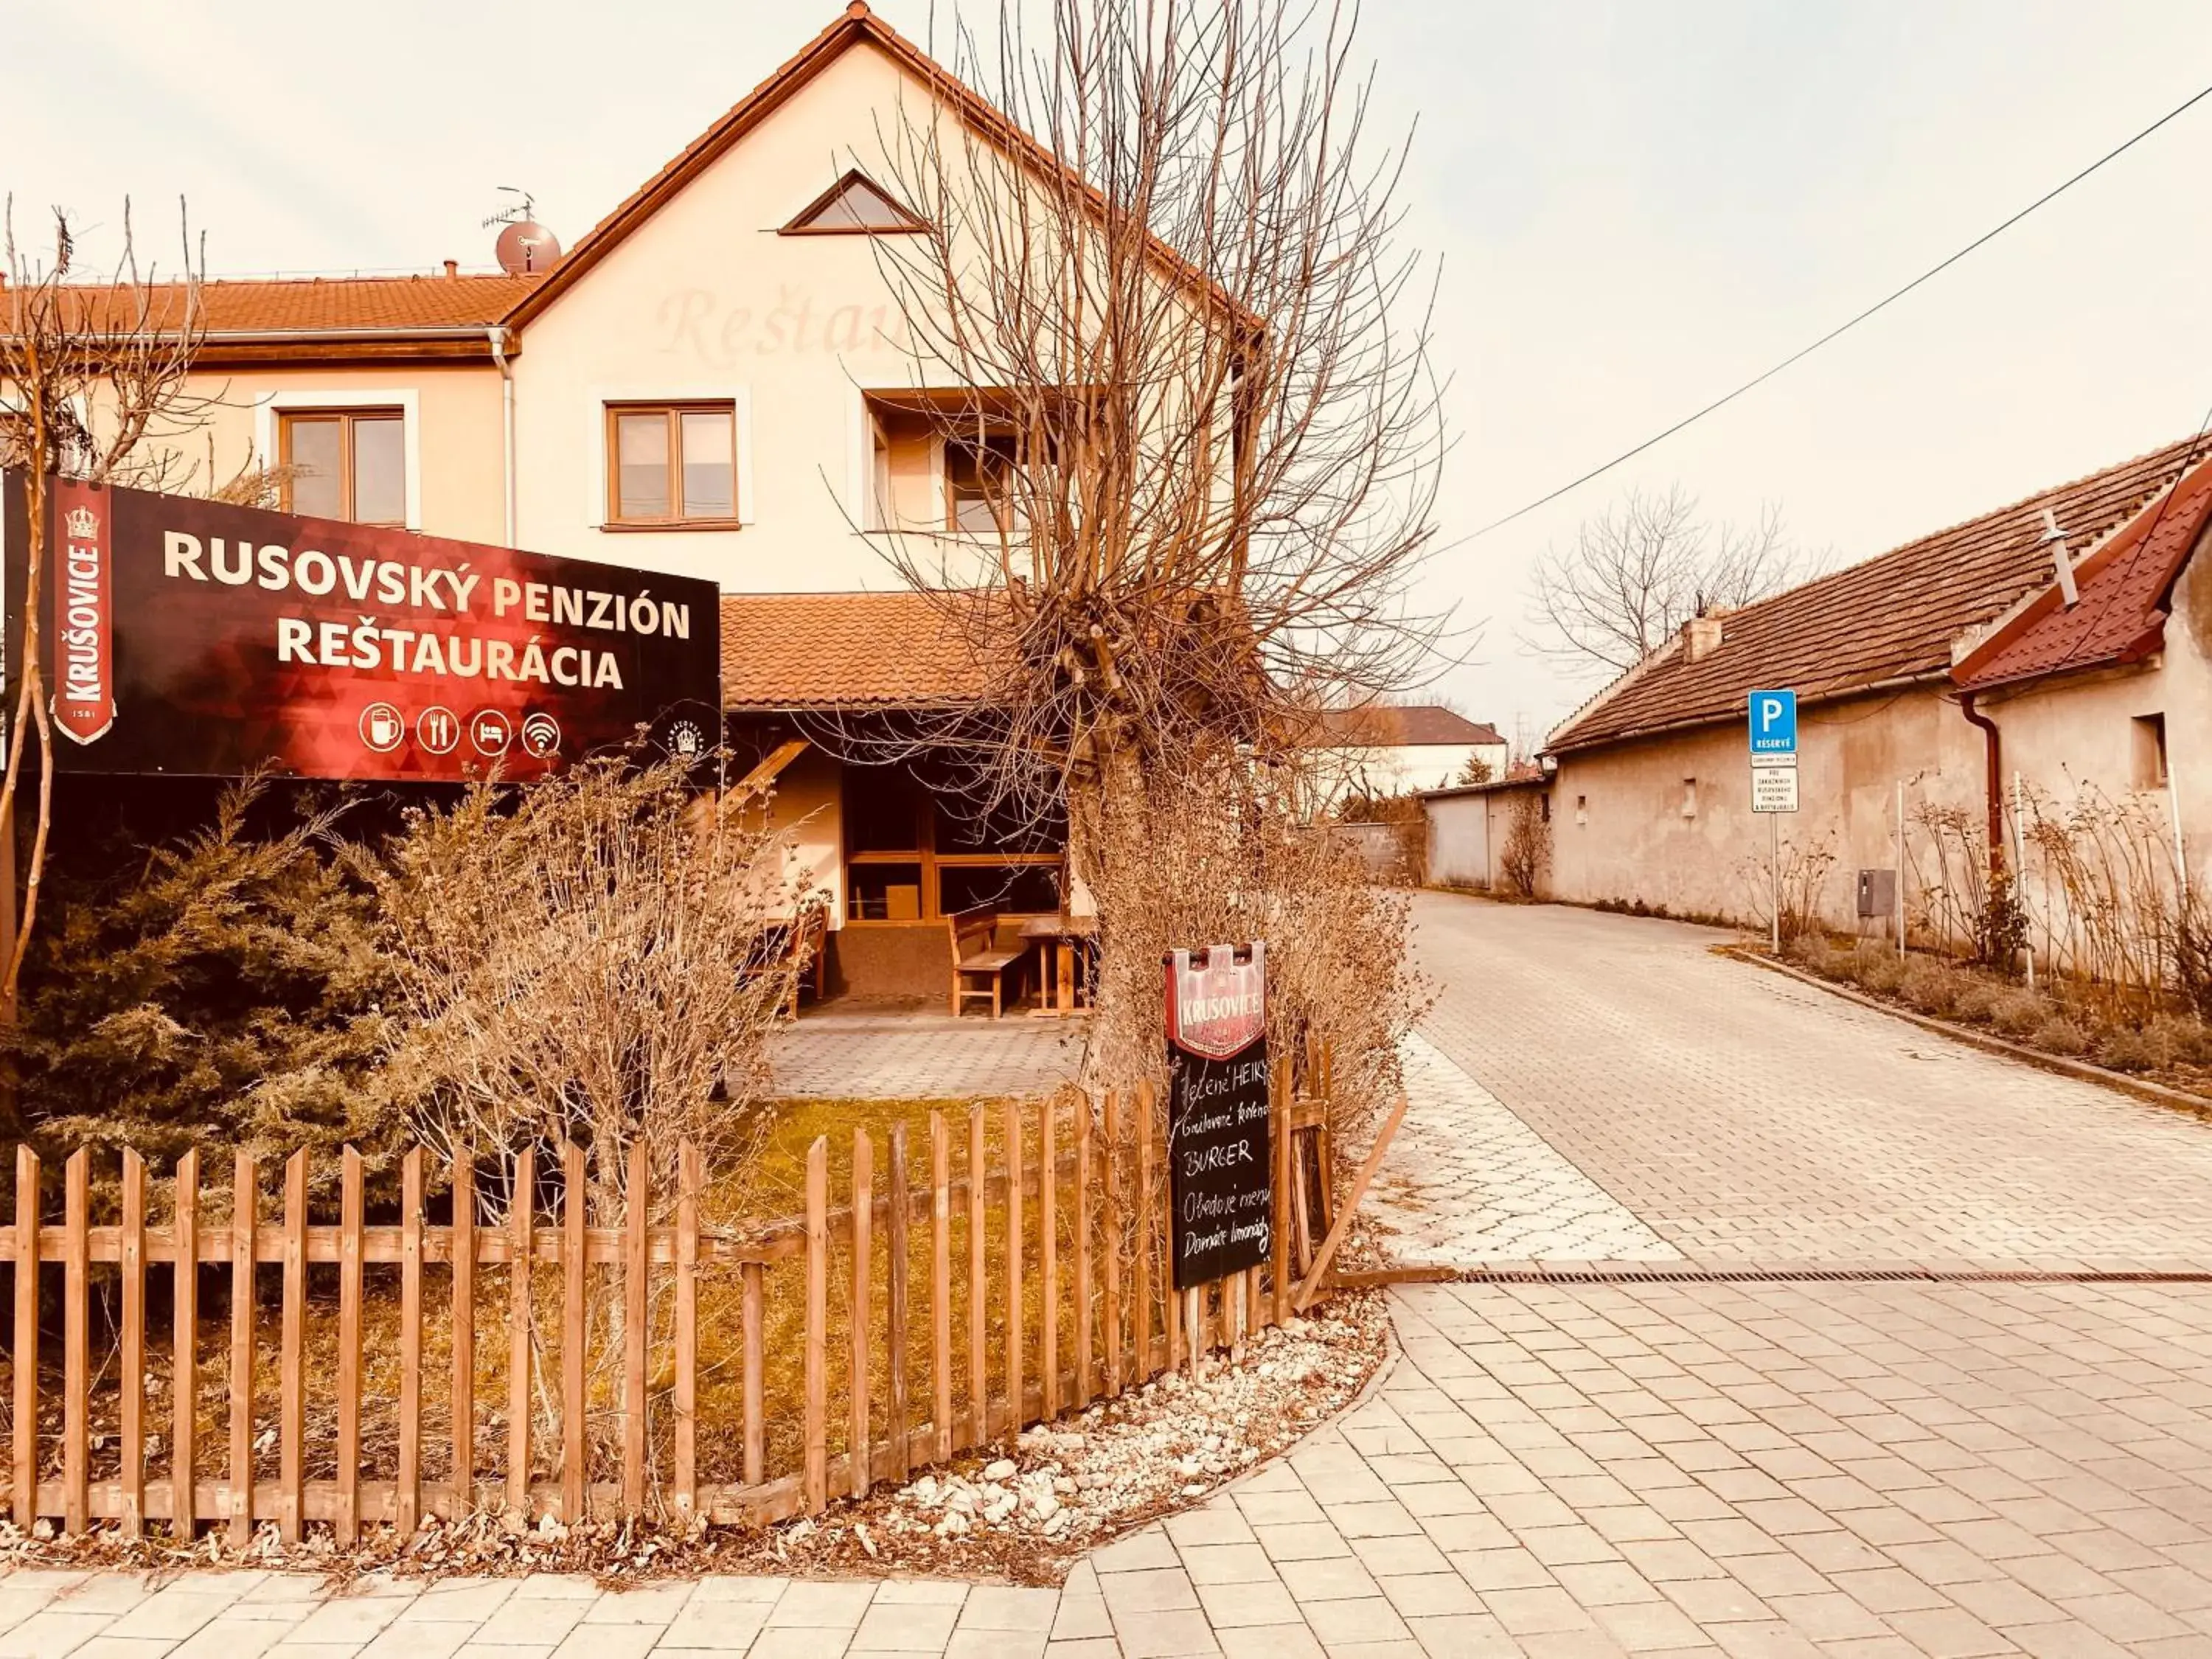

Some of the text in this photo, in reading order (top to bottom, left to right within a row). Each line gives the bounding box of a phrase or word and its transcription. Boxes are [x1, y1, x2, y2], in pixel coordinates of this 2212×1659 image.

[164, 530, 690, 640] RUSOVSKÝ PENZIÓN
[61, 544, 101, 702] KRUŠOVICE
[277, 614, 624, 690] REŠTAURÁCIA
[1762, 698, 1783, 732] P
[1183, 994, 1262, 1026] KRUŠOVICE
[1183, 1139, 1253, 1177] BURGER
